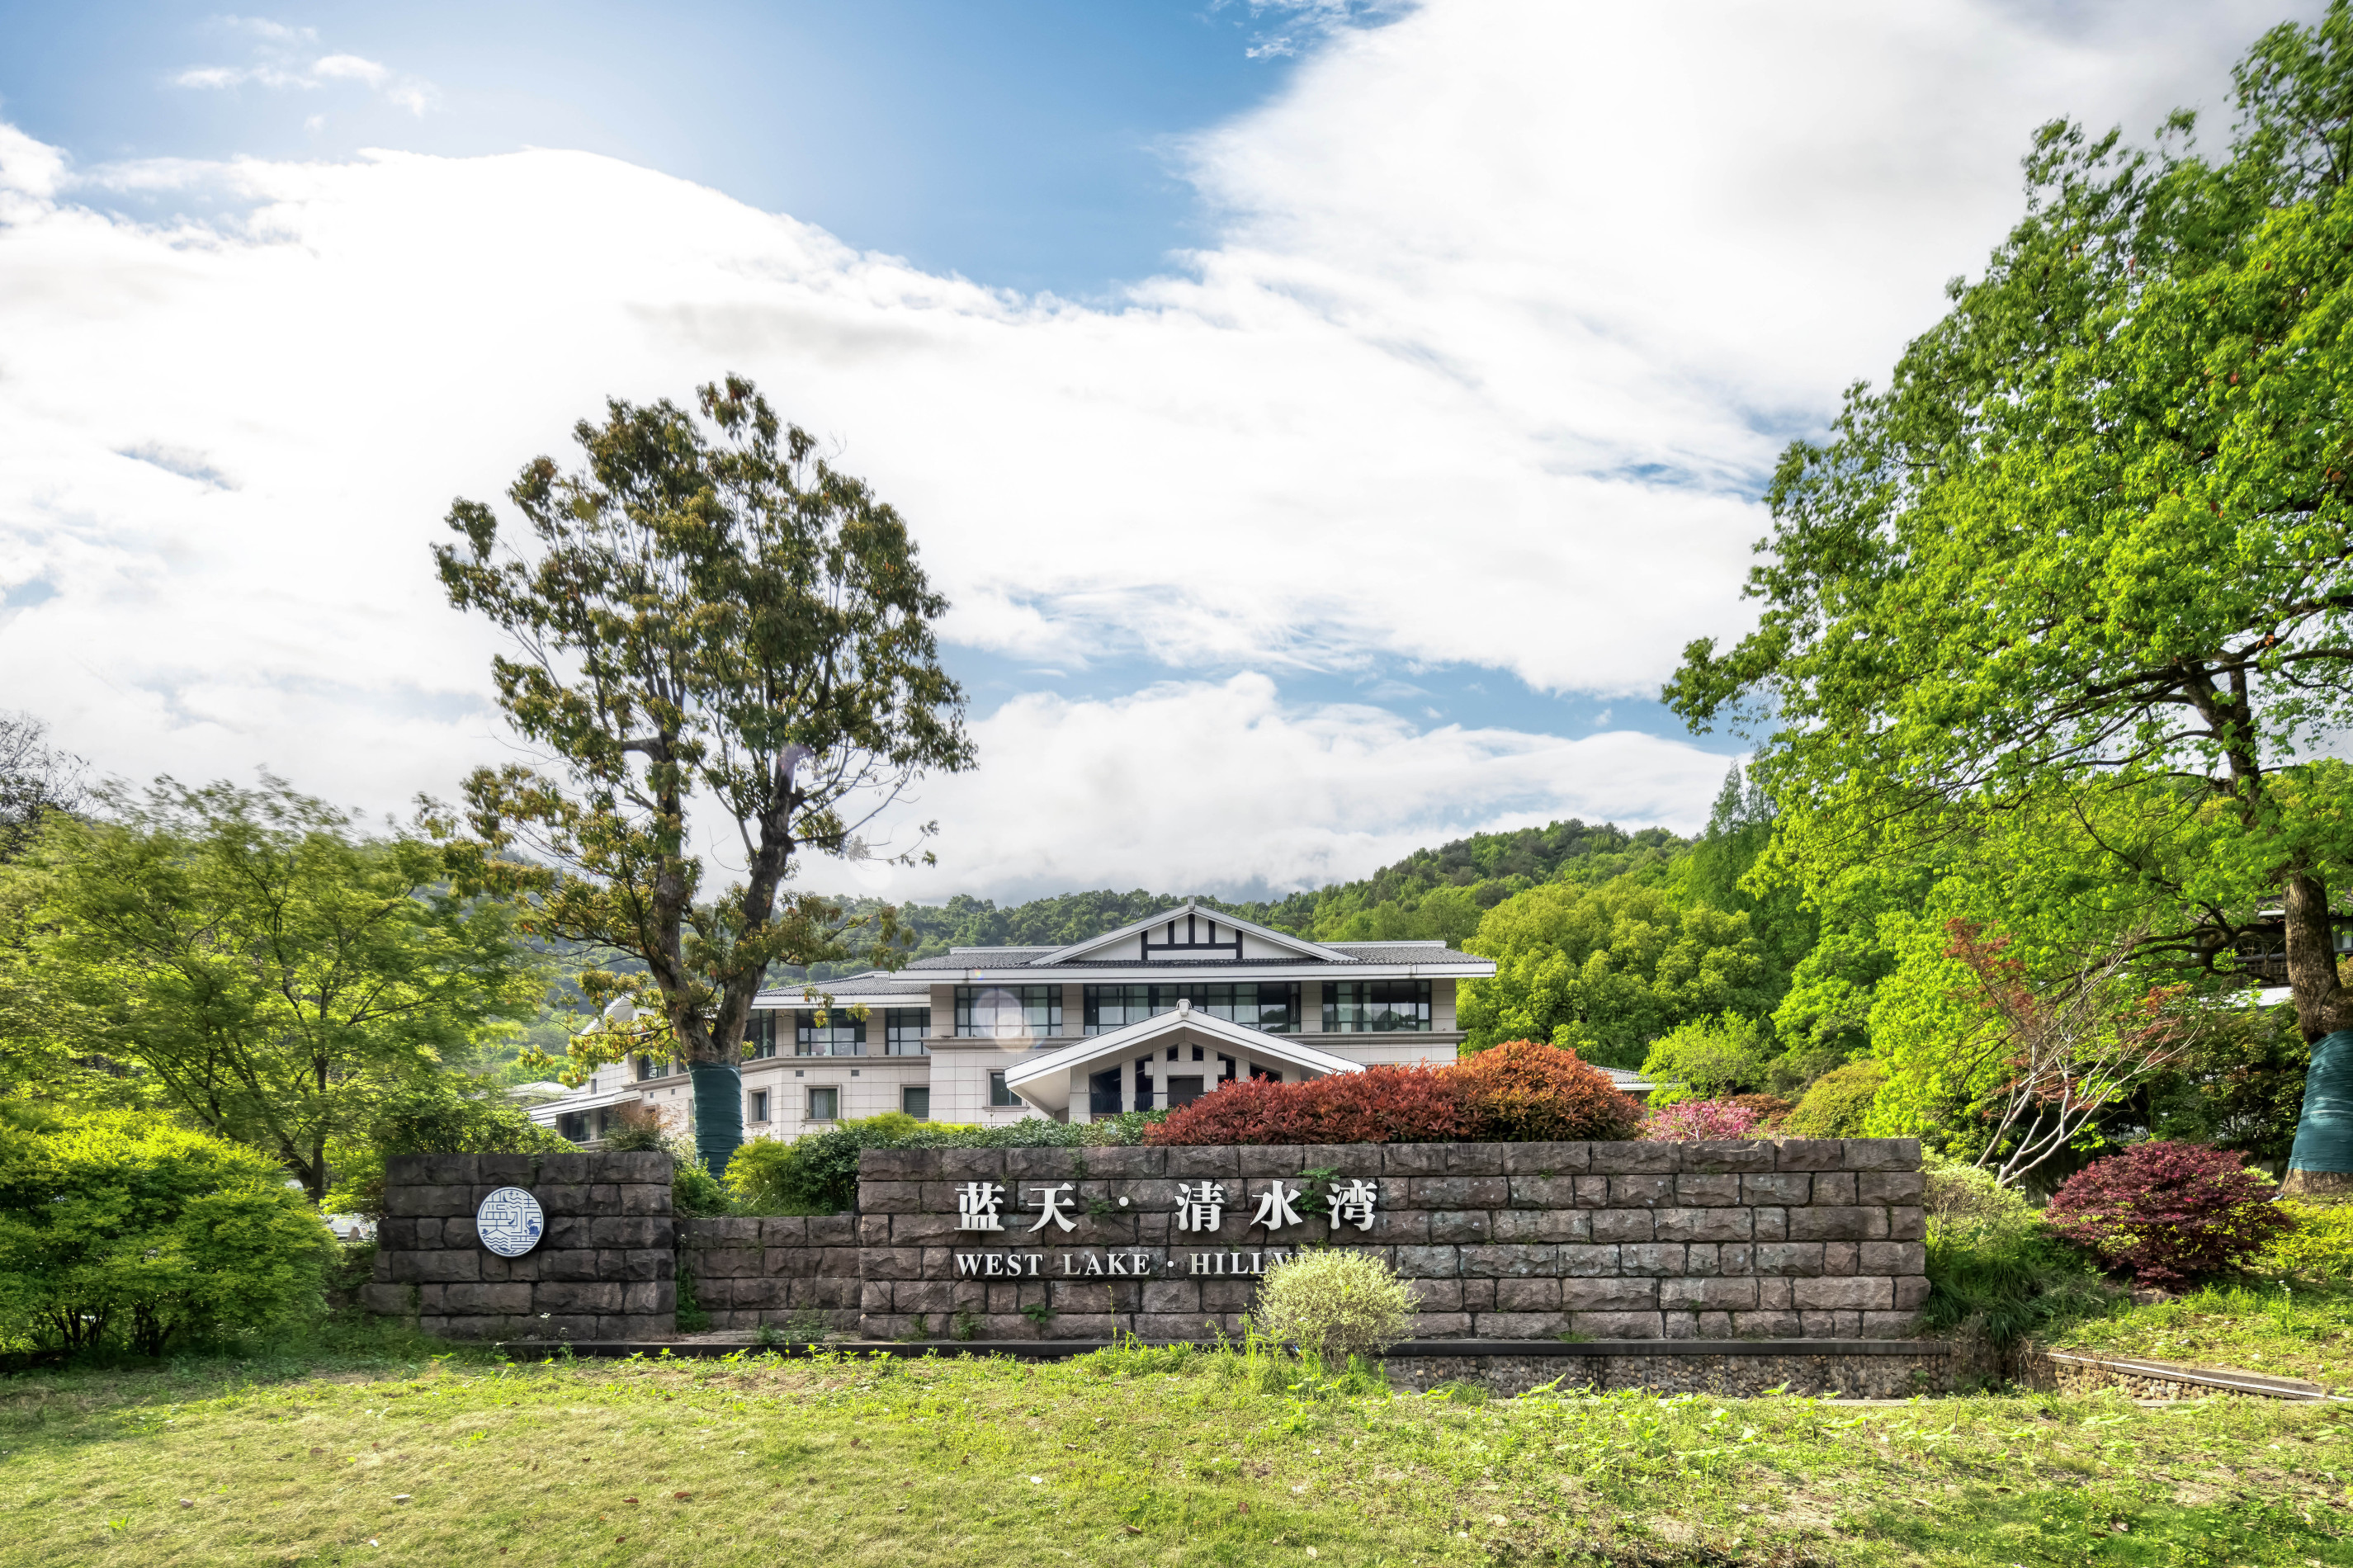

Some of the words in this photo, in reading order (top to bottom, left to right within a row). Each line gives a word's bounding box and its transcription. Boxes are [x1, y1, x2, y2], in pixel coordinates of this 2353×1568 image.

[956, 1254, 1043, 1277] WEST
[1062, 1254, 1151, 1276] LAKE
[1188, 1253, 1362, 1275] HILLV
